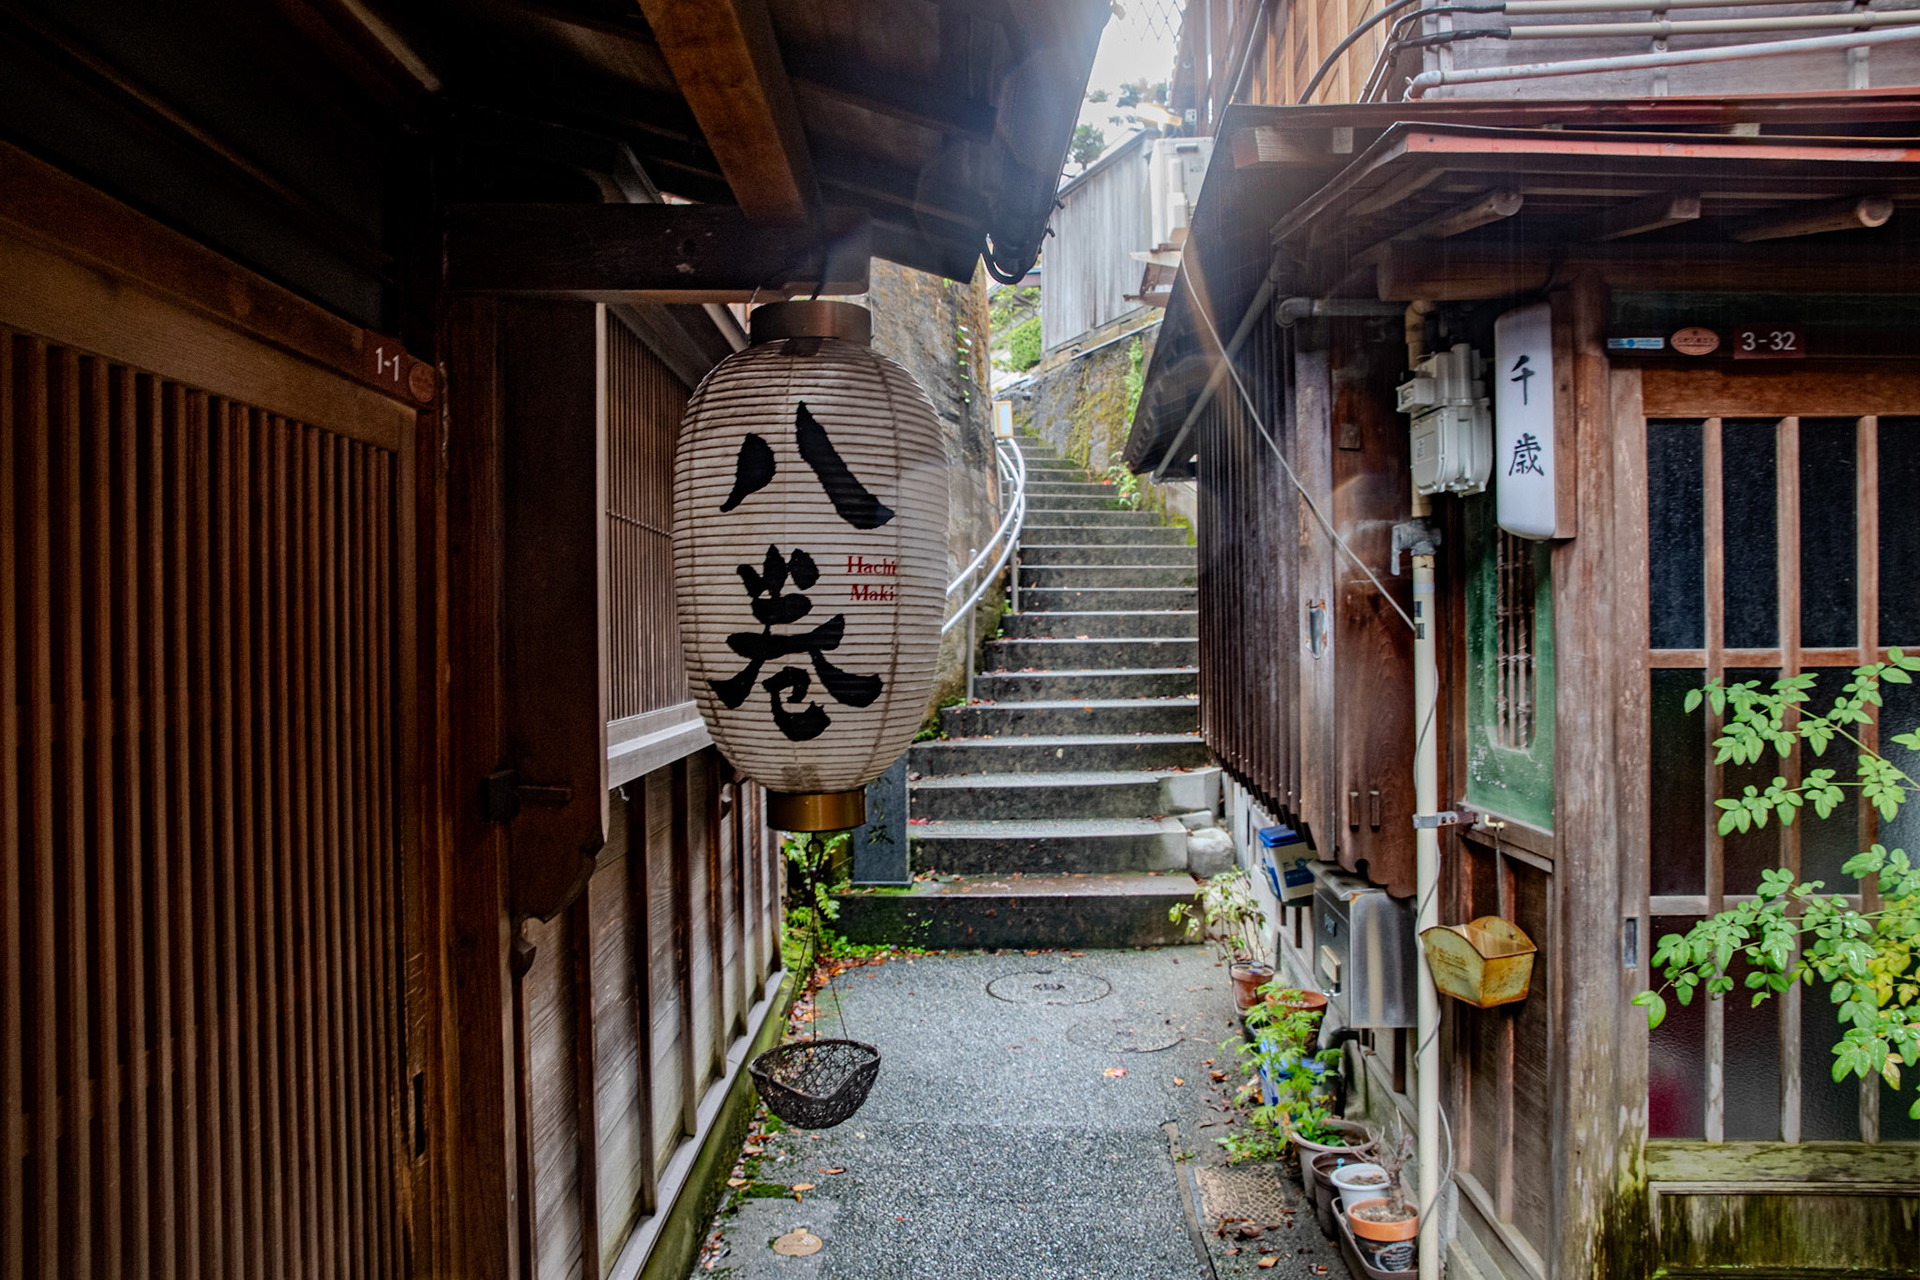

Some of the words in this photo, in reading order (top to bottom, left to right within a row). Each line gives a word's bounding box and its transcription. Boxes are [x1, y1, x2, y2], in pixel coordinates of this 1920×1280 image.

[1741, 331, 1797, 351] 3-32
[375, 347, 400, 382] 1-1
[1508, 354, 1545, 477] 千歳
[707, 400, 895, 742] 八巻
[847, 555, 897, 576] Hachi
[850, 583, 895, 602] Maki
